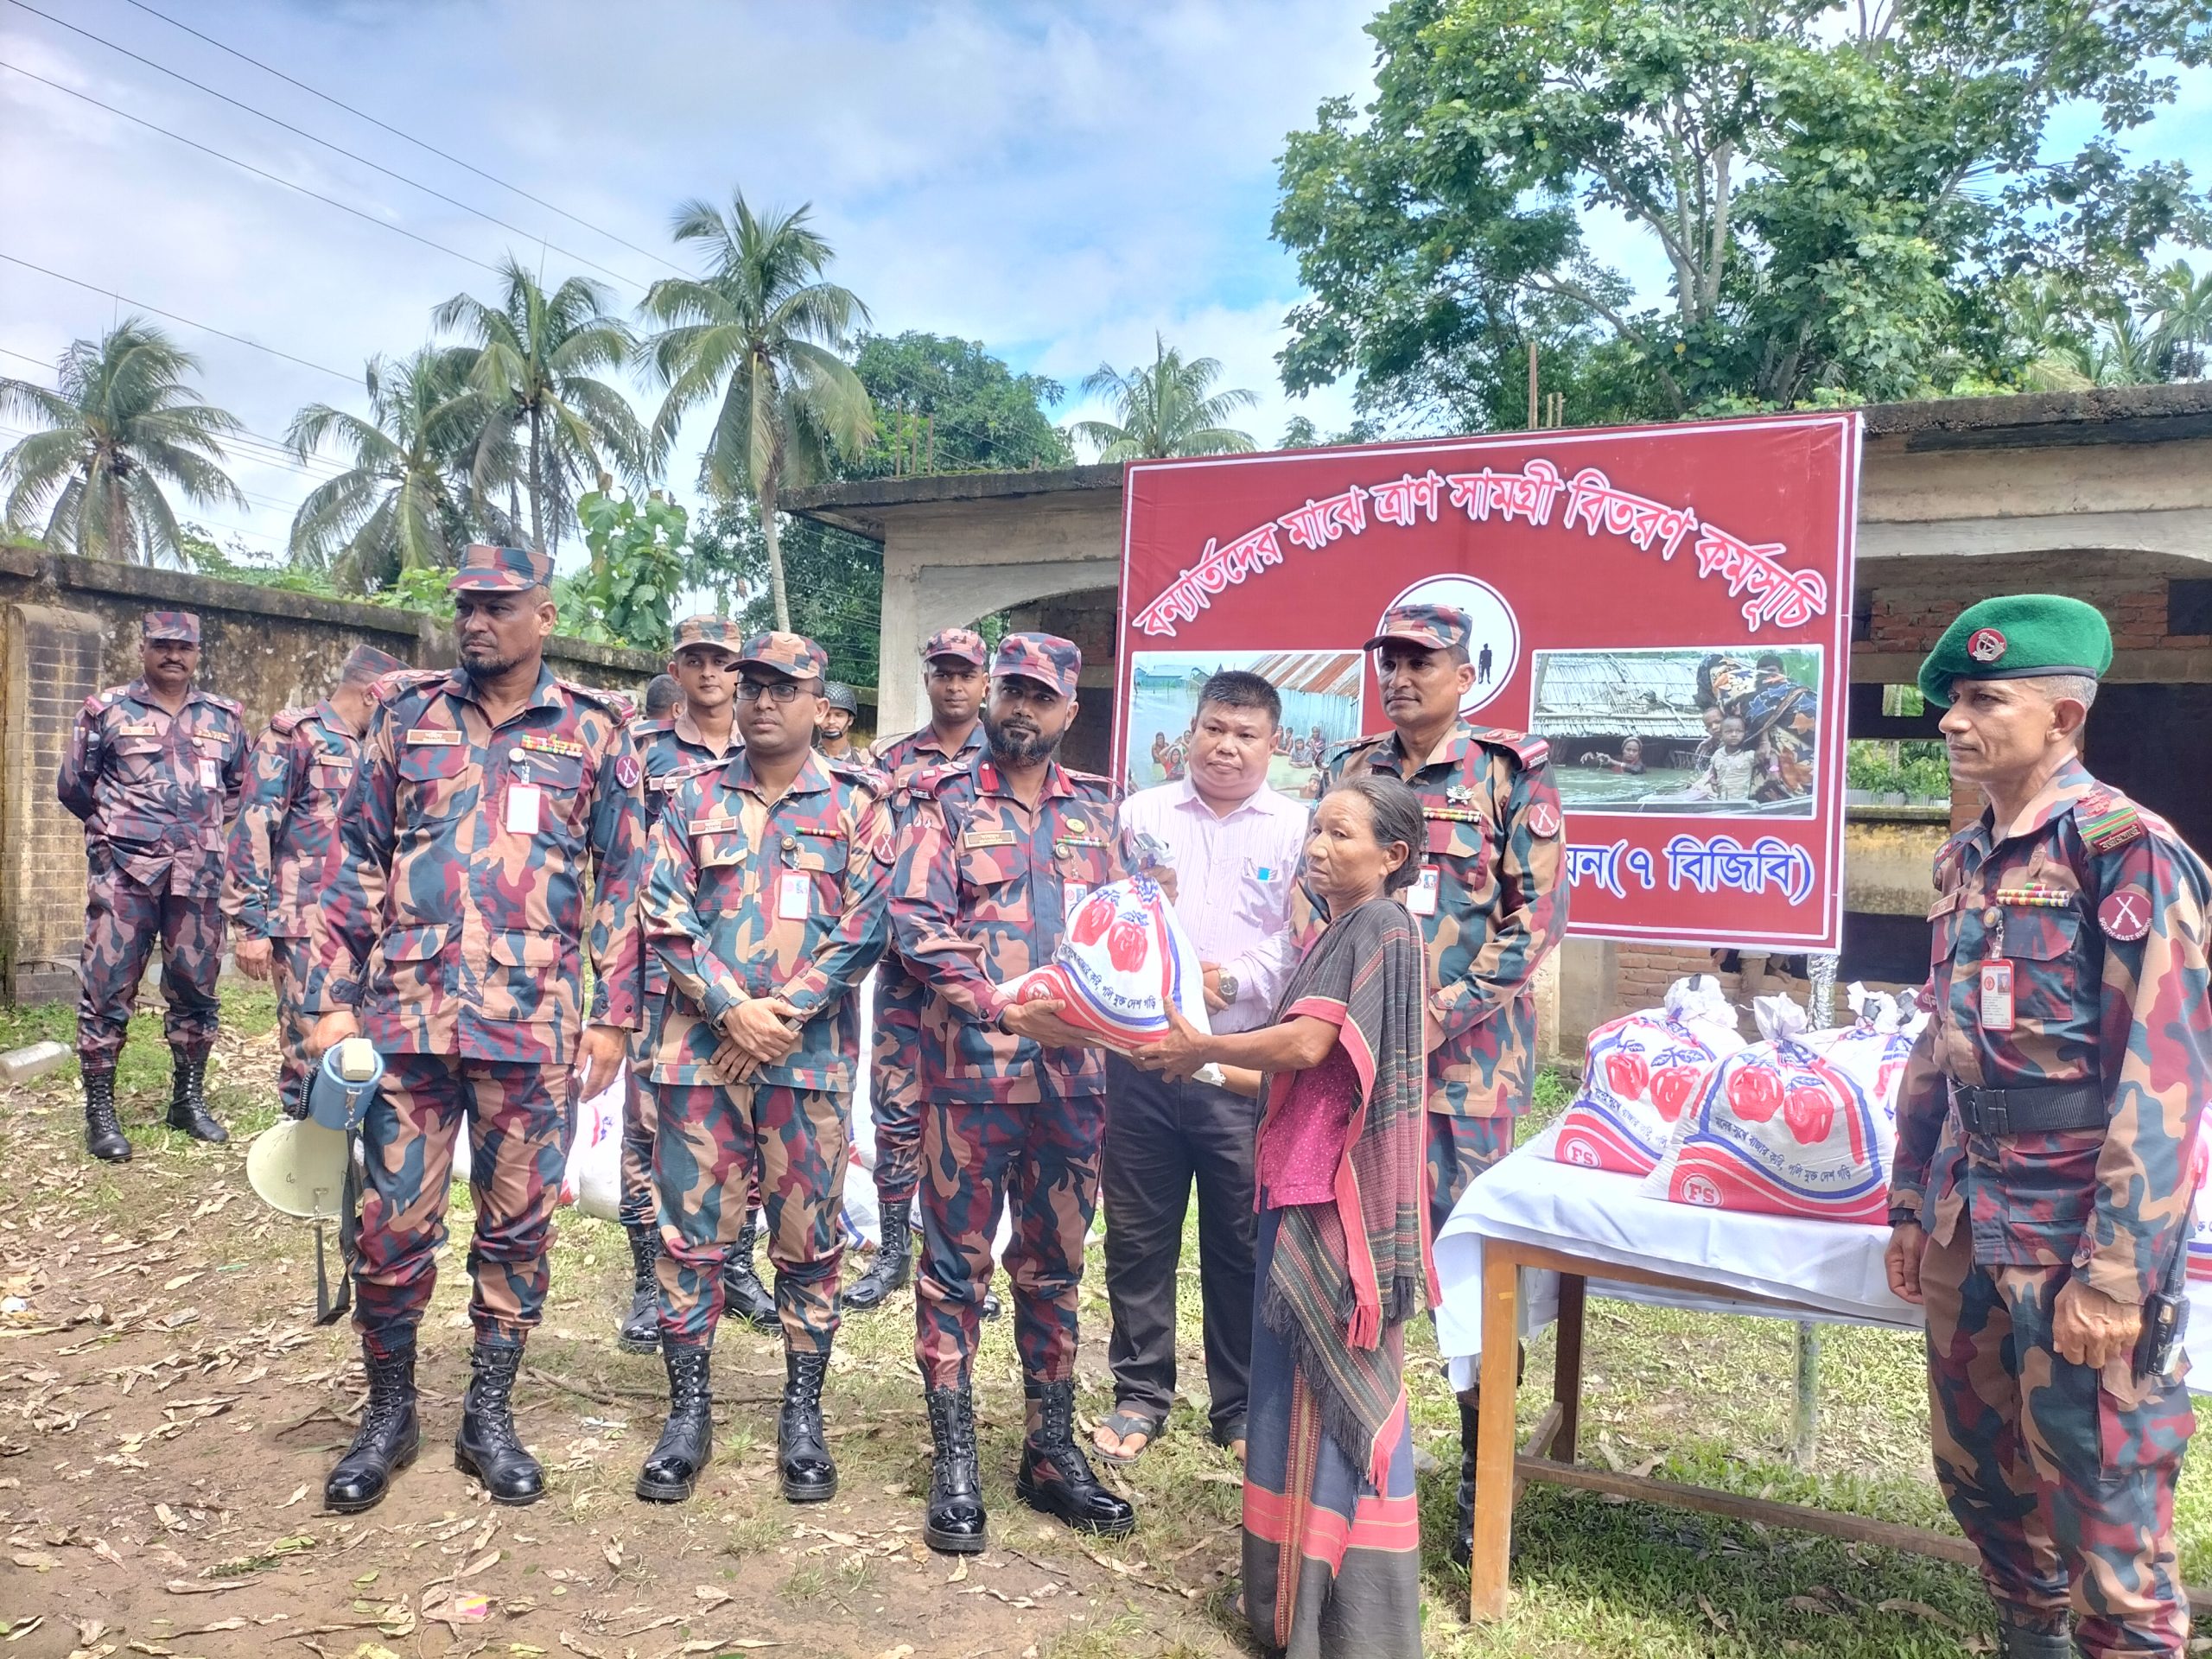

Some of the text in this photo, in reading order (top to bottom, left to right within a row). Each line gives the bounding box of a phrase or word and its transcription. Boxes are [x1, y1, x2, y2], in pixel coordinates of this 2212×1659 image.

[1133, 459, 1827, 636] বন্যার্তদের মাঝে ত্রাণ সামগ্রী বিতরণ কর্মসূচি
[1662, 834, 1815, 906] বিজিবি)
[2099, 917, 2153, 941] SOUTH-EAST REGION
[1572, 1147, 1593, 1166] FS
[1804, 1170, 1818, 1183] মুক্ত
[1821, 1170, 1835, 1182] দেশ
[1688, 1183, 1714, 1203] FS
